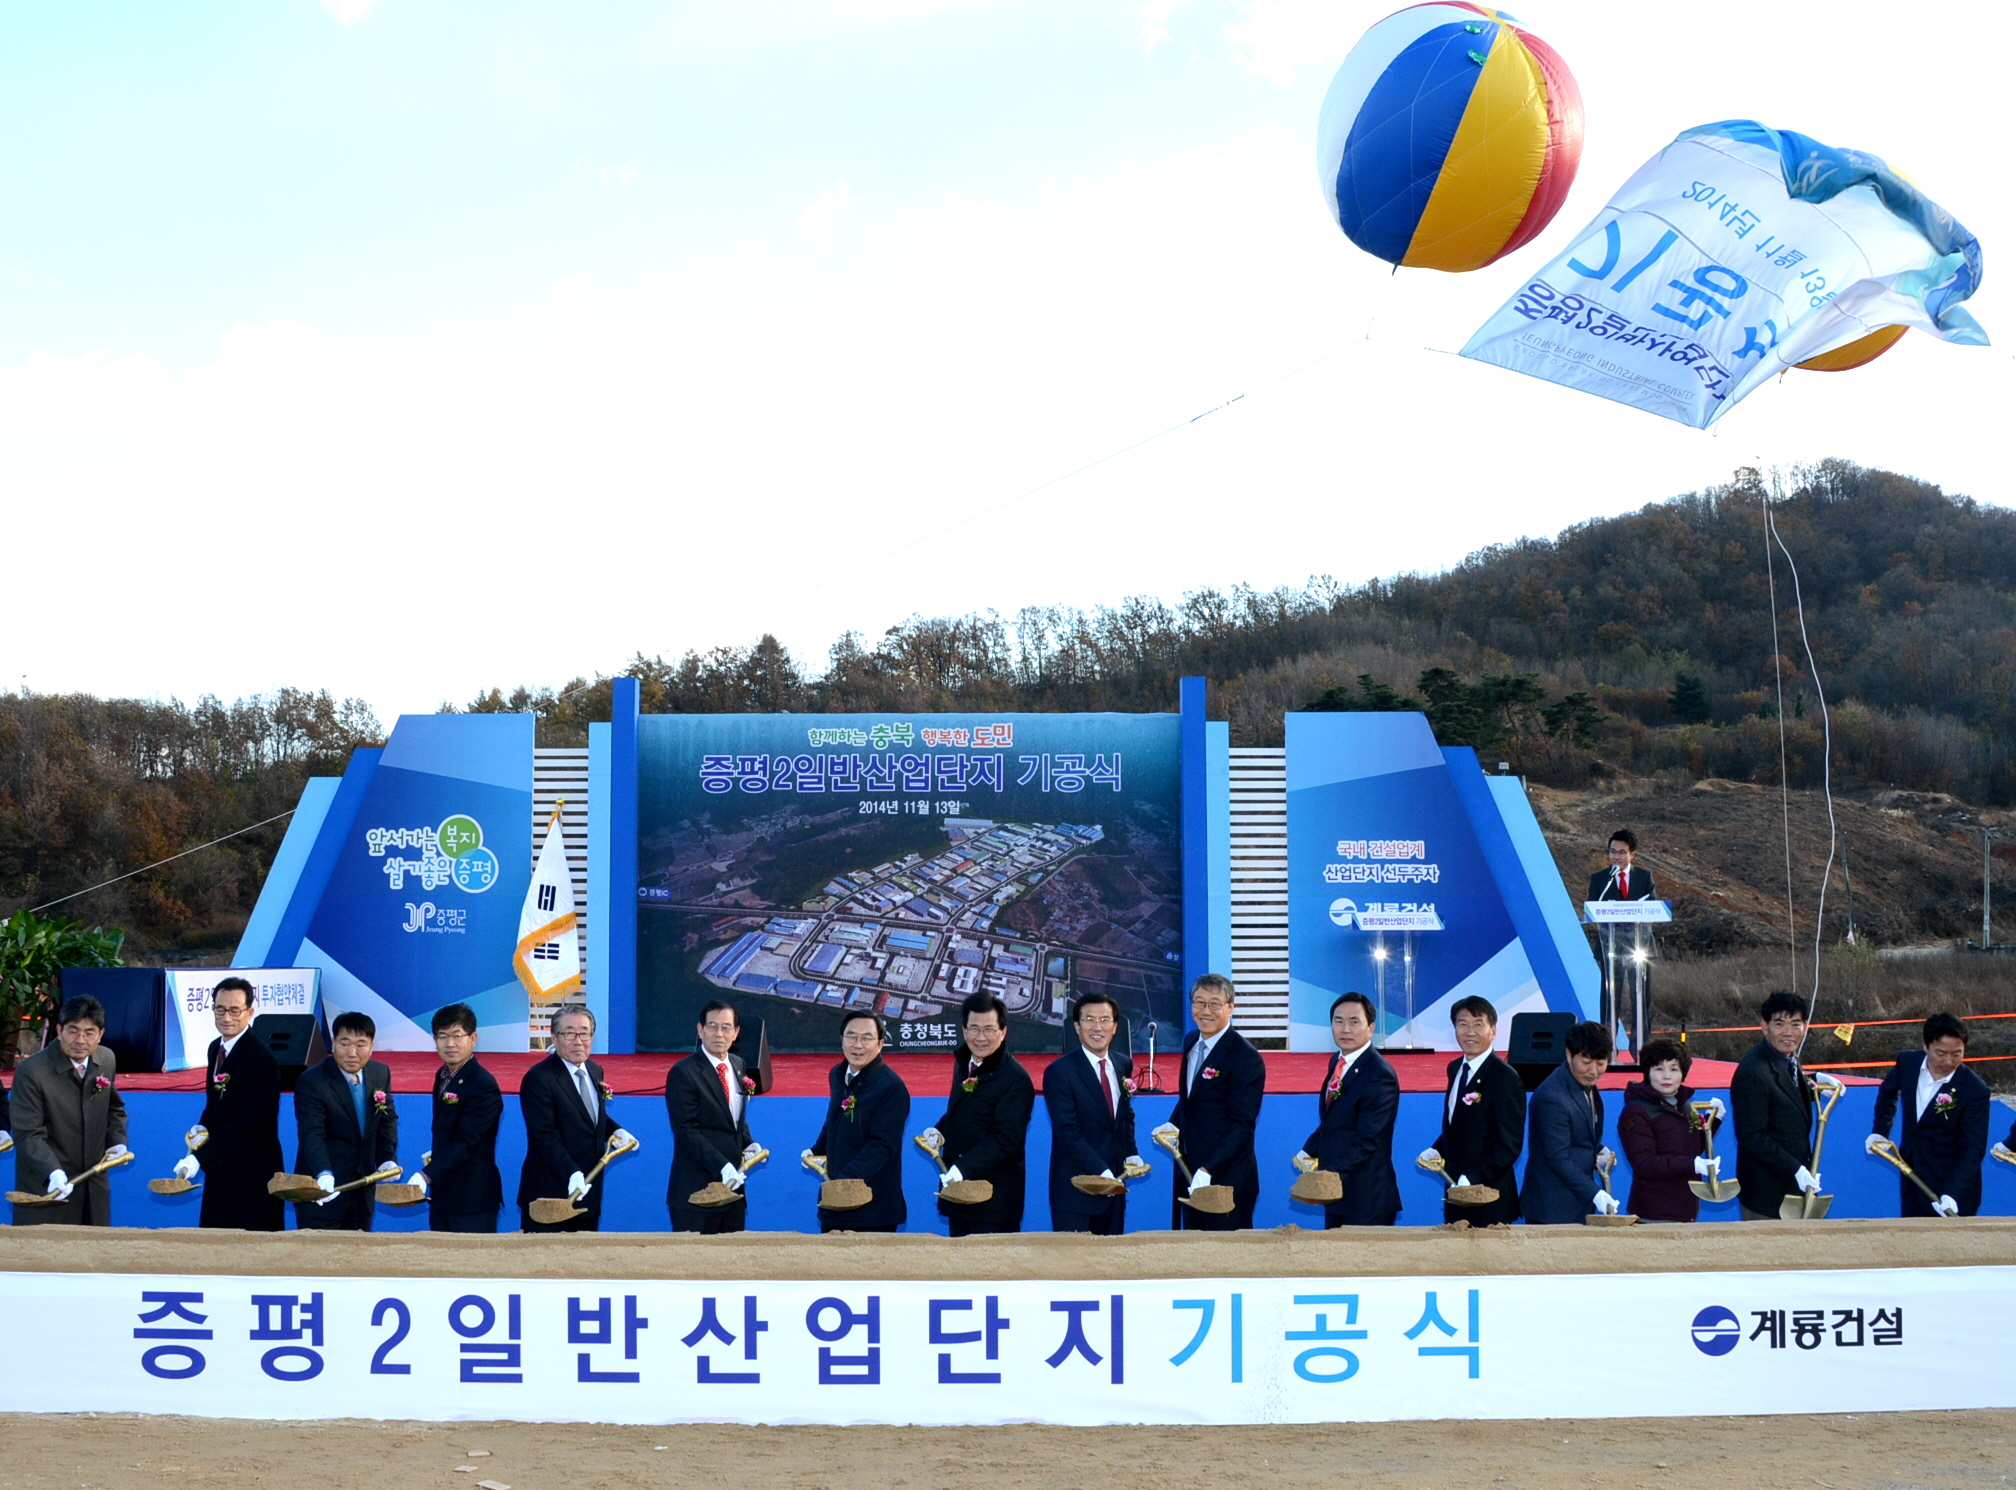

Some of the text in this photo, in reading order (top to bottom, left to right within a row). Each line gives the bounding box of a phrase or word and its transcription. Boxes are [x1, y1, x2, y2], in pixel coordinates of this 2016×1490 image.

[808, 722, 1014, 750] 함께하는 충북 행복한 도민
[699, 752, 1123, 794] 증평2일반산업단지 기공식
[858, 799, 961, 815] 2014년 11월 13일
[367, 824, 476, 855] 앞서가는 복지
[1338, 840, 1425, 859] 국내 건설업계
[384, 855, 492, 889] 살기좋은 증평
[1323, 864, 1440, 883] 산업단지 선두주자
[436, 909, 467, 926] 증평군
[425, 926, 466, 934] Jeung Pyeong
[900, 1022, 957, 1040] 충청북도
[899, 1039, 958, 1048] CHUNGCHEONGBUK-DO
[1748, 1306, 1904, 1351] 계룡건설
